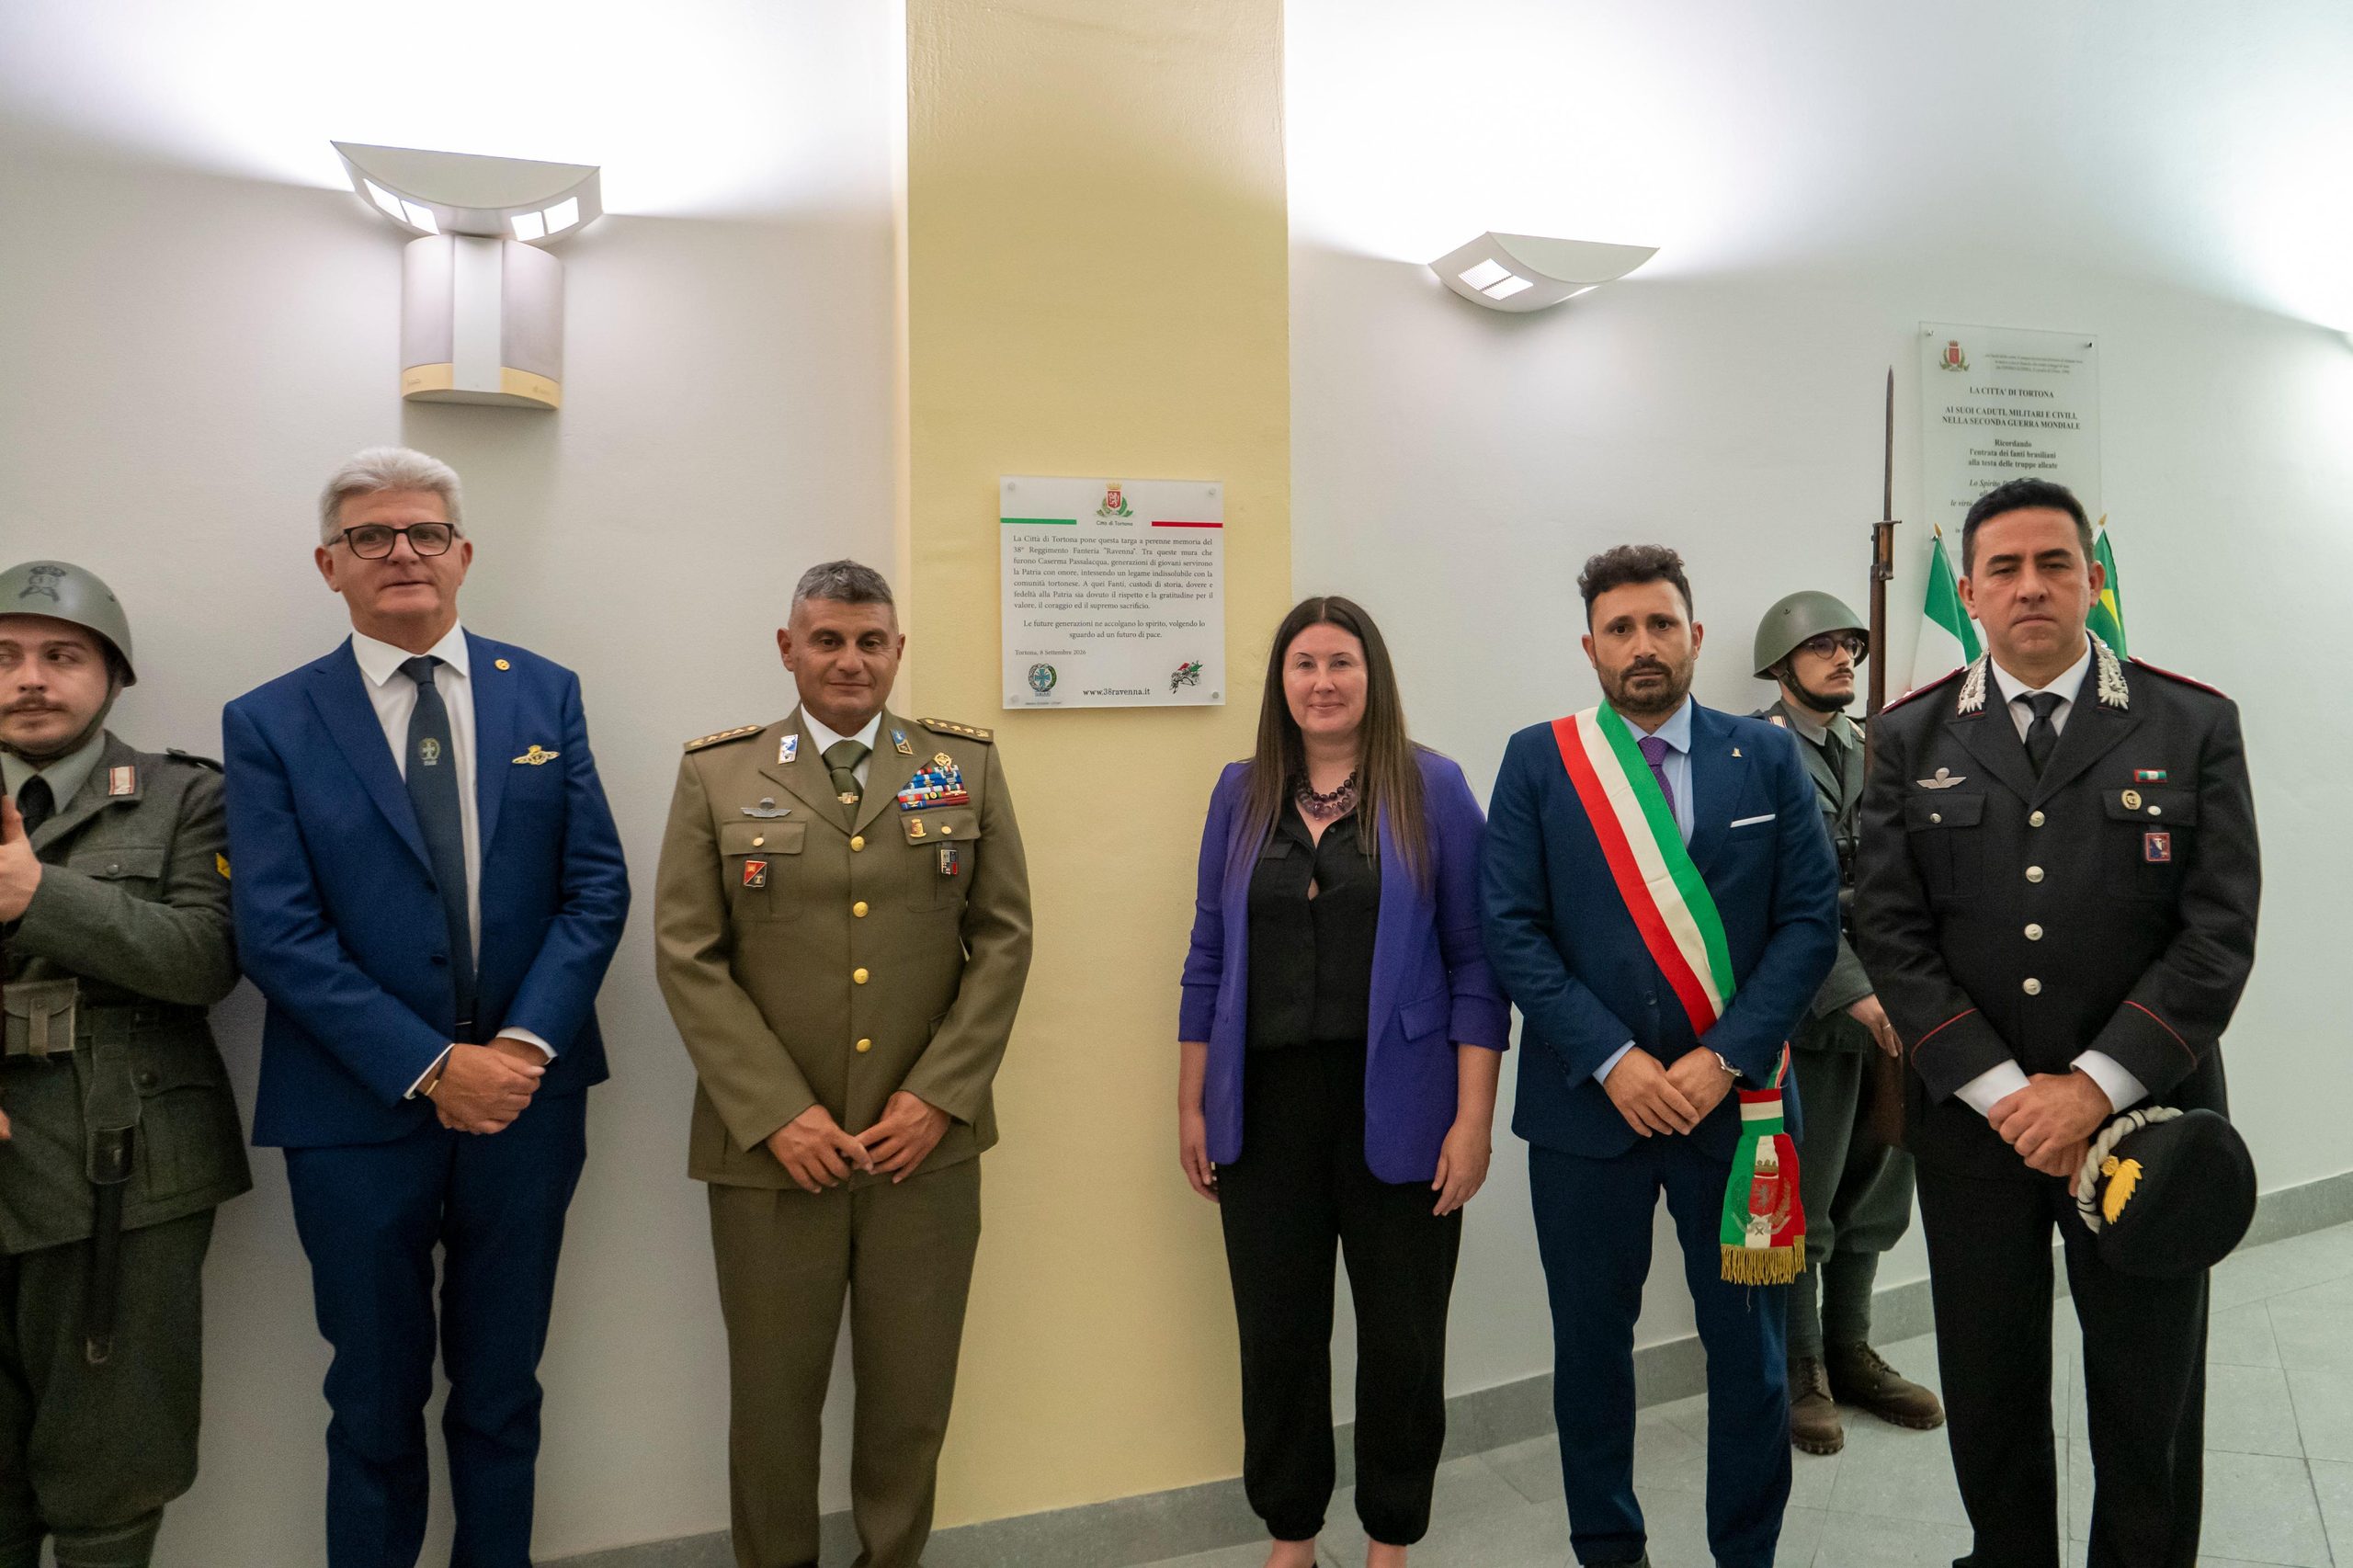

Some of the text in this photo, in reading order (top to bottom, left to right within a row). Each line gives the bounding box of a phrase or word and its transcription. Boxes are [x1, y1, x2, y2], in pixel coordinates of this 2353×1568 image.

[1981, 387, 2007, 395] CITTA'
[2019, 389, 2054, 398] TORTONA
[2009, 409, 2044, 418] MILITARI
[1942, 416, 2081, 430] NELLA SECONDA GUERRA MONDIALE
[1995, 439, 2032, 447] Ricordando
[1969, 448, 1997, 456] l'entrata
[2026, 450, 2056, 459] brasiliani
[2015, 461, 2036, 469] truppe
[1980, 479, 2001, 488] Spirito
[1029, 546, 1069, 555] Reggimento
[1156, 549, 1177, 557] queste
[1069, 558, 1109, 567] Passalacqua,
[1118, 591, 1143, 600] rispetto
[1159, 592, 1194, 600] gratitudine
[1055, 620, 1093, 629] generazioni
[1104, 620, 1136, 628] accolgano
[1168, 620, 1198, 629] volgendo
[1069, 631, 1095, 640] sguardo
[1083, 688, 1150, 696] www.38ravenna.it
